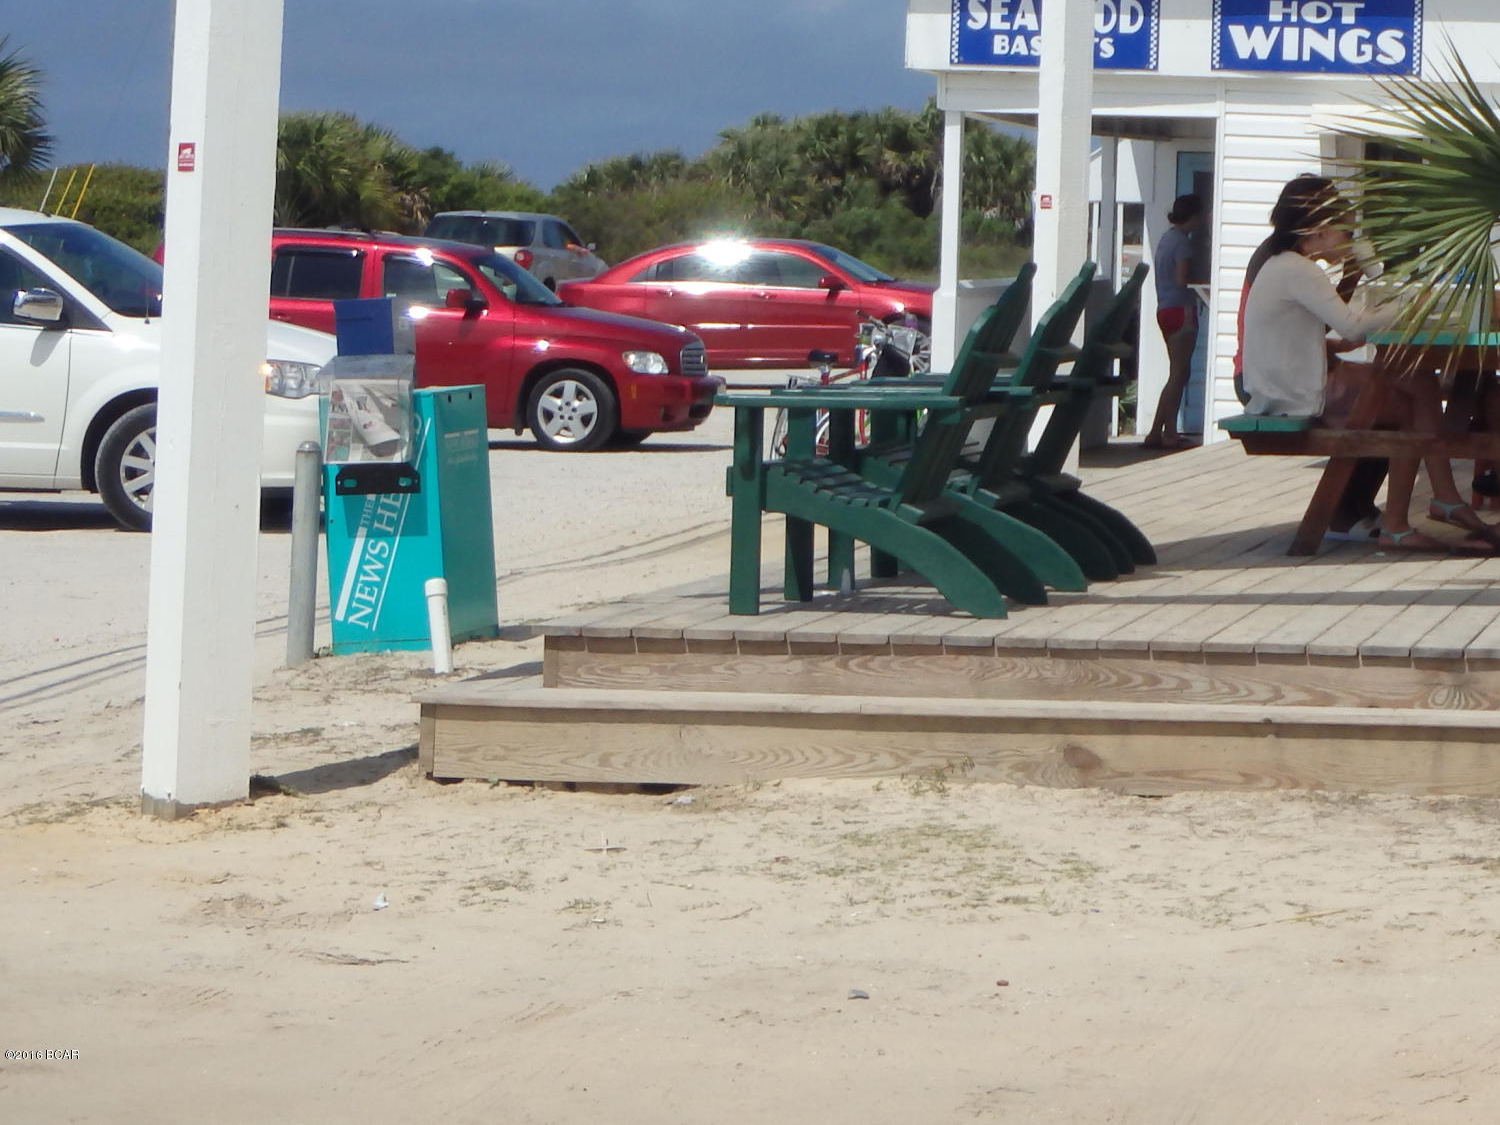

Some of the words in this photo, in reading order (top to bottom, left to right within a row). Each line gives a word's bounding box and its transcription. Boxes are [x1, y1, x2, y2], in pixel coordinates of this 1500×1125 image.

[1268, 0, 1365, 24] HOT
[1228, 24, 1406, 65] WINGS
[347, 539, 390, 629] NEWS
